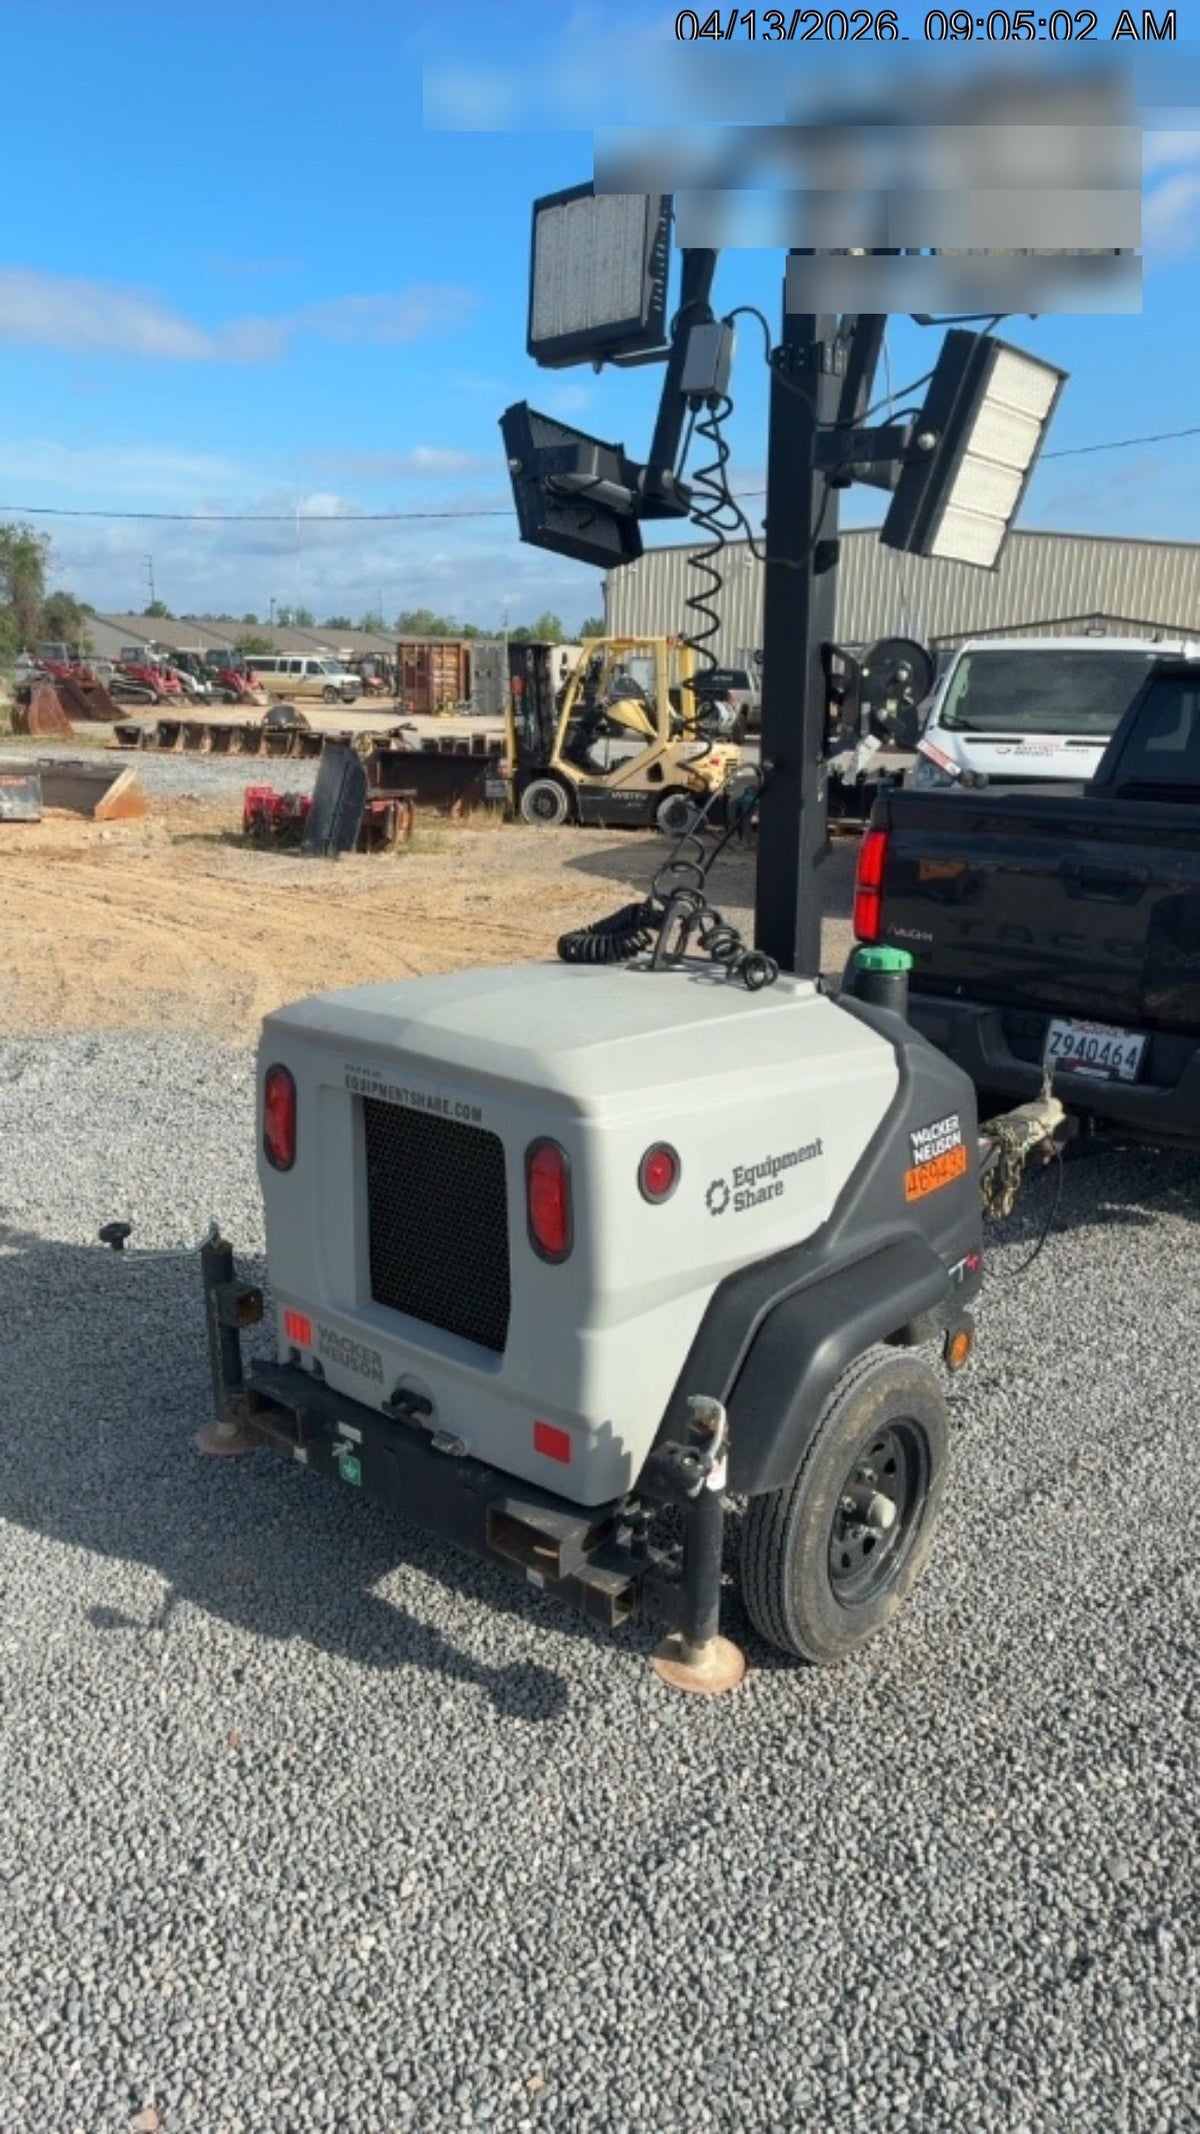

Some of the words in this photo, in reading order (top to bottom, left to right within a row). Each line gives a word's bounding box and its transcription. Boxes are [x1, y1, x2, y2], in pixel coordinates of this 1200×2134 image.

[1049, 1031, 1137, 1070] Z940464
[344, 1073, 483, 1122] EQUIPMENTSHARE.COM
[910, 1113, 960, 1148] WACKER
[912, 1129, 962, 1166] NEUSON
[731, 1137, 824, 1189] Equipment
[733, 1179, 784, 1213] Share
